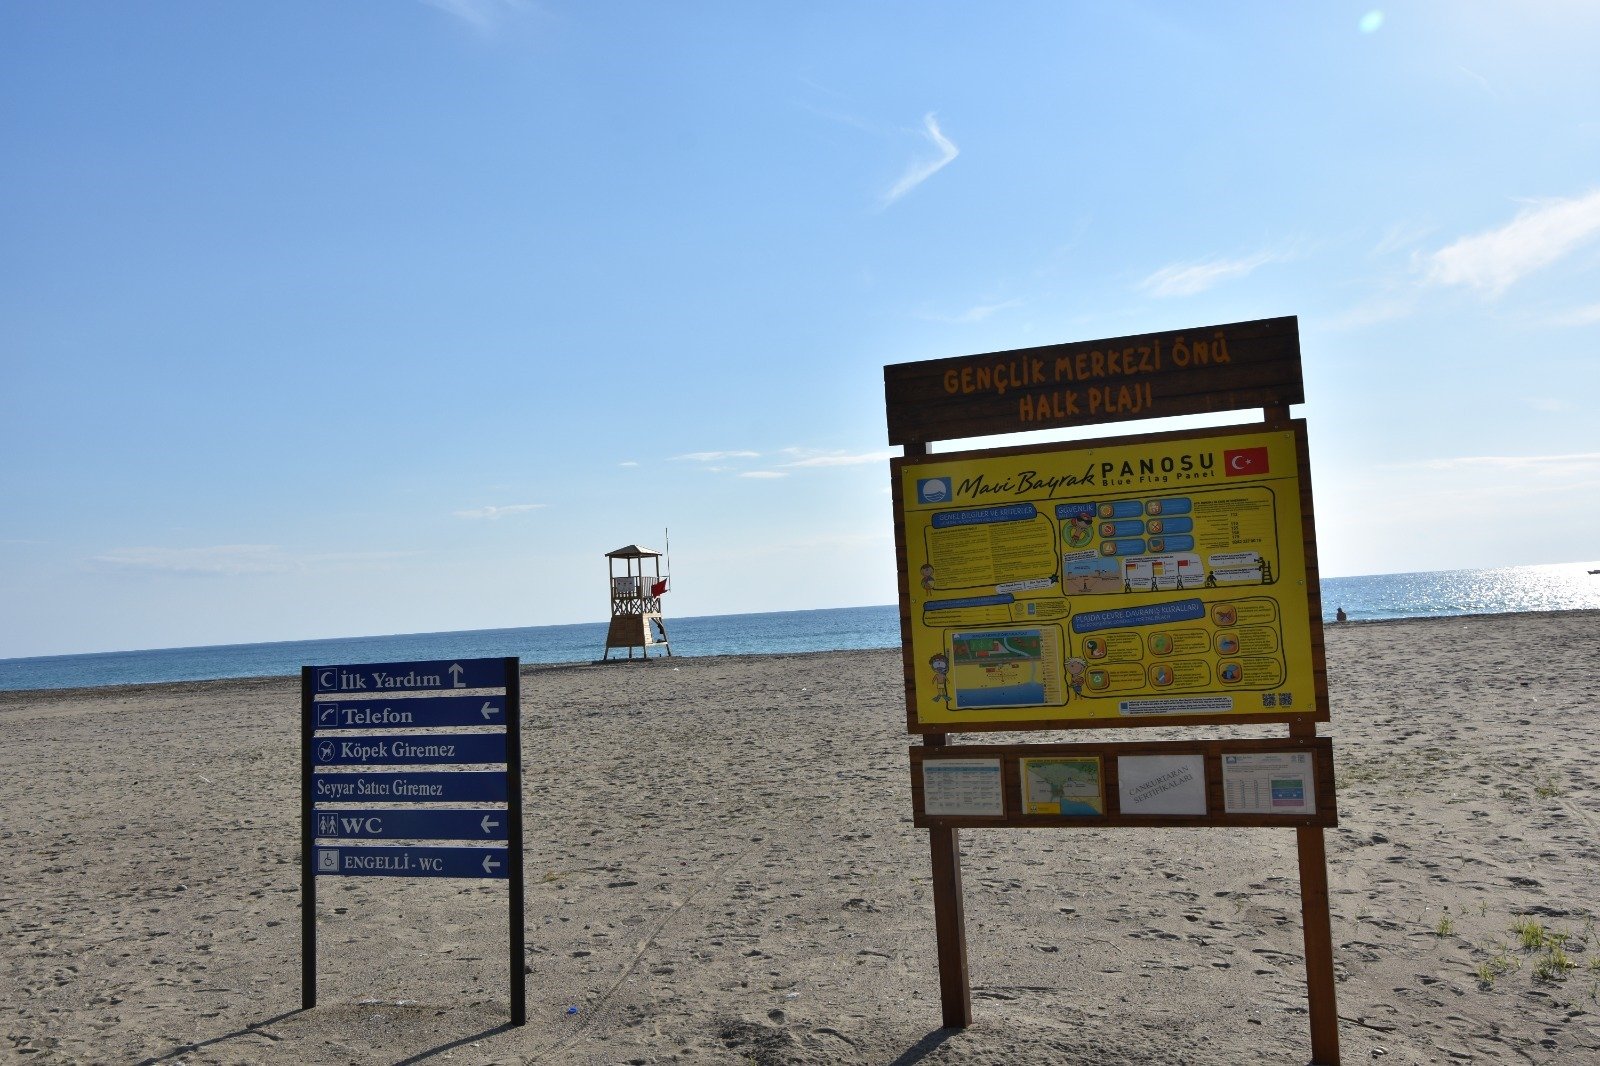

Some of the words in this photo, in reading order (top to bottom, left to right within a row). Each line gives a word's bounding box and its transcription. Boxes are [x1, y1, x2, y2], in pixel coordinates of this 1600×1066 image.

[943, 355, 1046, 395] GENÇLİK
[1054, 339, 1162, 382] MERKEZİ
[1171, 330, 1231, 367] ÖNÜ
[1019, 390, 1079, 422] HALK
[1087, 382, 1152, 416] PLAJI
[956, 474, 1015, 498] Mavi
[1014, 463, 1095, 497] Bayrak
[1101, 452, 1214, 478] PANOSU
[1102, 478, 1131, 487] Blue
[1139, 475, 1168, 483] Flag
[1176, 470, 1214, 480] Panel
[340, 670, 367, 690] İlk
[372, 671, 442, 688] Yardım
[342, 708, 413, 724] Telefon
[341, 742, 388, 761] Köpek
[391, 741, 455, 757] Giremez
[317, 779, 354, 798] Seyyar
[357, 779, 389, 795] Satıcı
[392, 779, 443, 796] Giremez
[1129, 764, 1189, 796] CANKURTARAN
[340, 817, 383, 834] WC
[344, 853, 410, 870] ENGELLİ
[419, 858, 443, 871] WC
